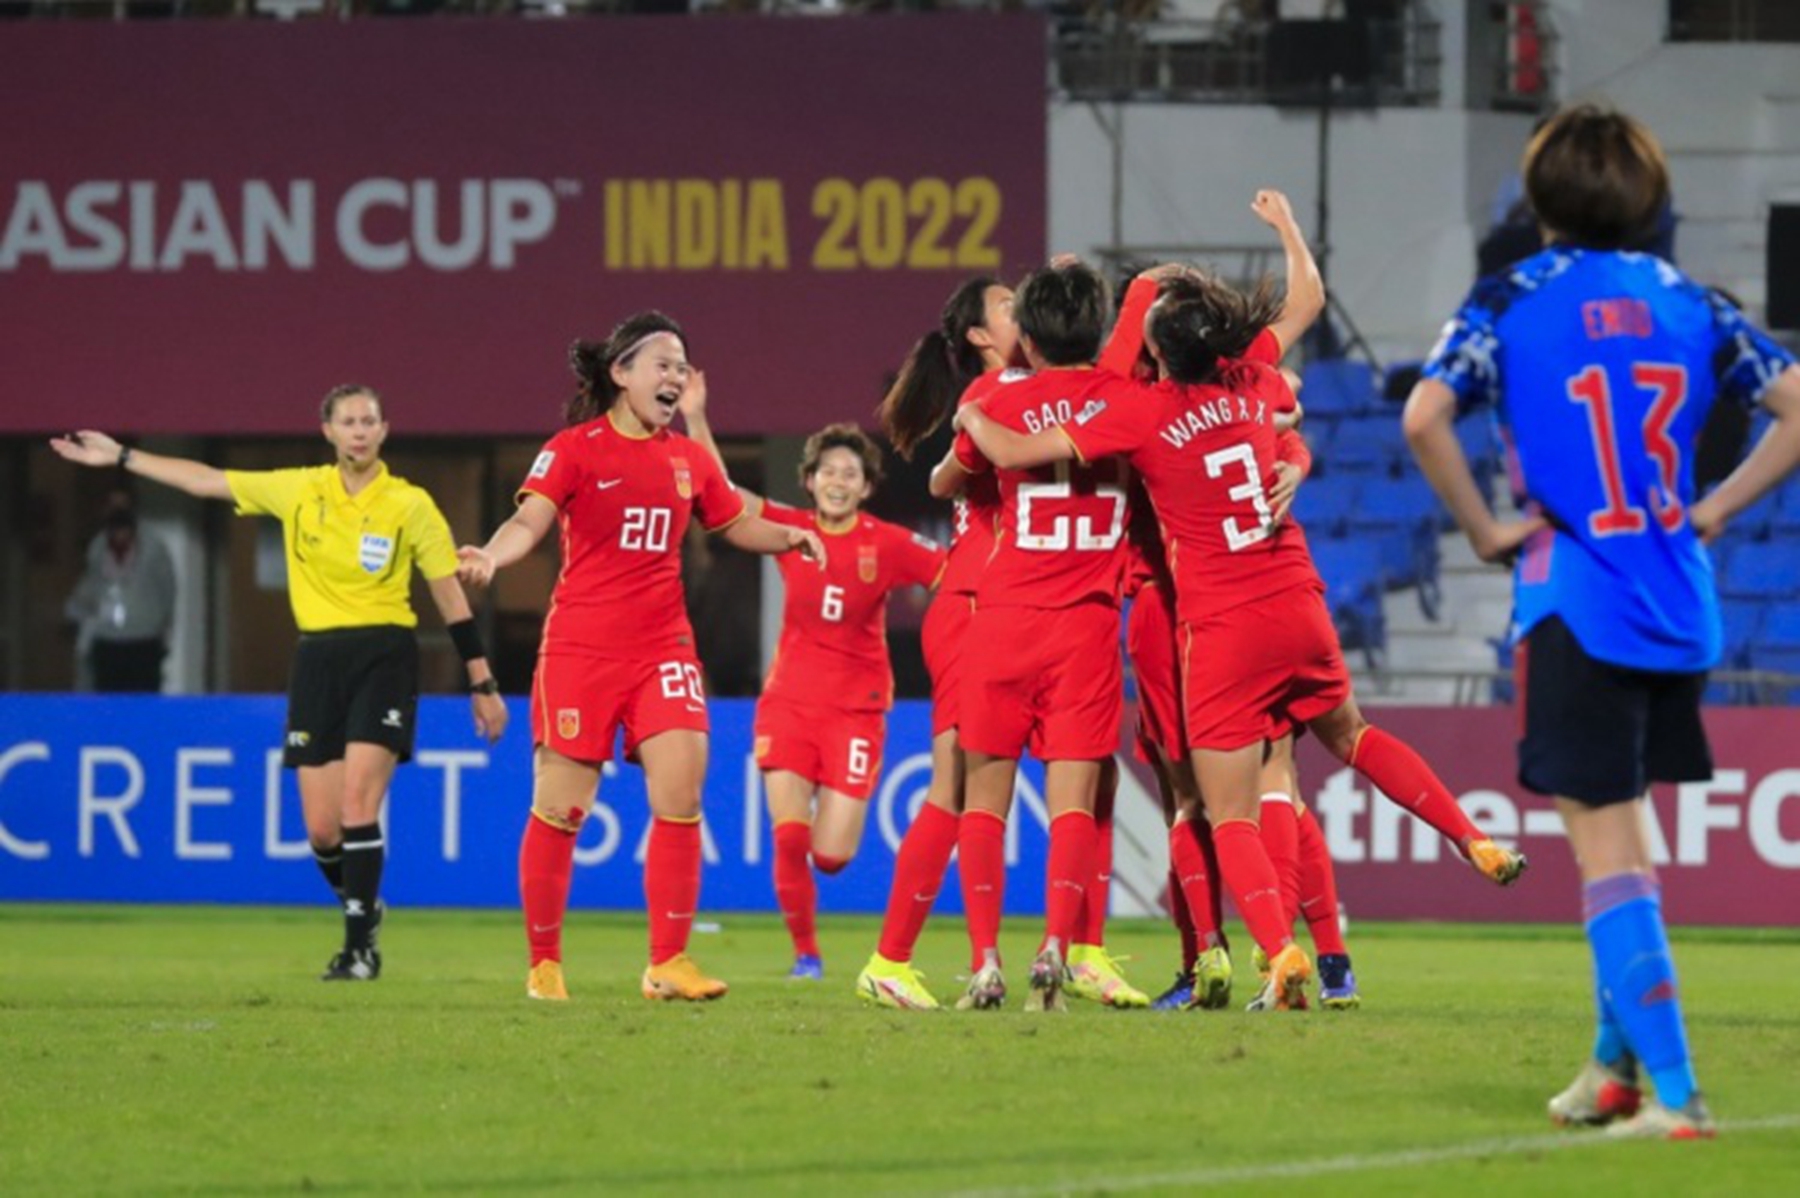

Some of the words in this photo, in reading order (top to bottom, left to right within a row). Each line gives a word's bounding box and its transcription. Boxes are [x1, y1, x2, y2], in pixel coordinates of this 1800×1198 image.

[0, 180, 314, 270] ASIAN
[336, 178, 557, 270] CUP
[604, 178, 788, 269] INDIA
[811, 177, 1001, 269] 2022
[1022, 399, 1072, 434] GAO
[1159, 396, 1232, 449] WANG
[1565, 362, 1689, 538] 13
[1203, 442, 1275, 552] 3
[619, 507, 671, 553] 20
[821, 585, 845, 622] 6
[659, 661, 705, 704] 20
[848, 738, 870, 775] 6
[0, 742, 489, 862] CREDT
